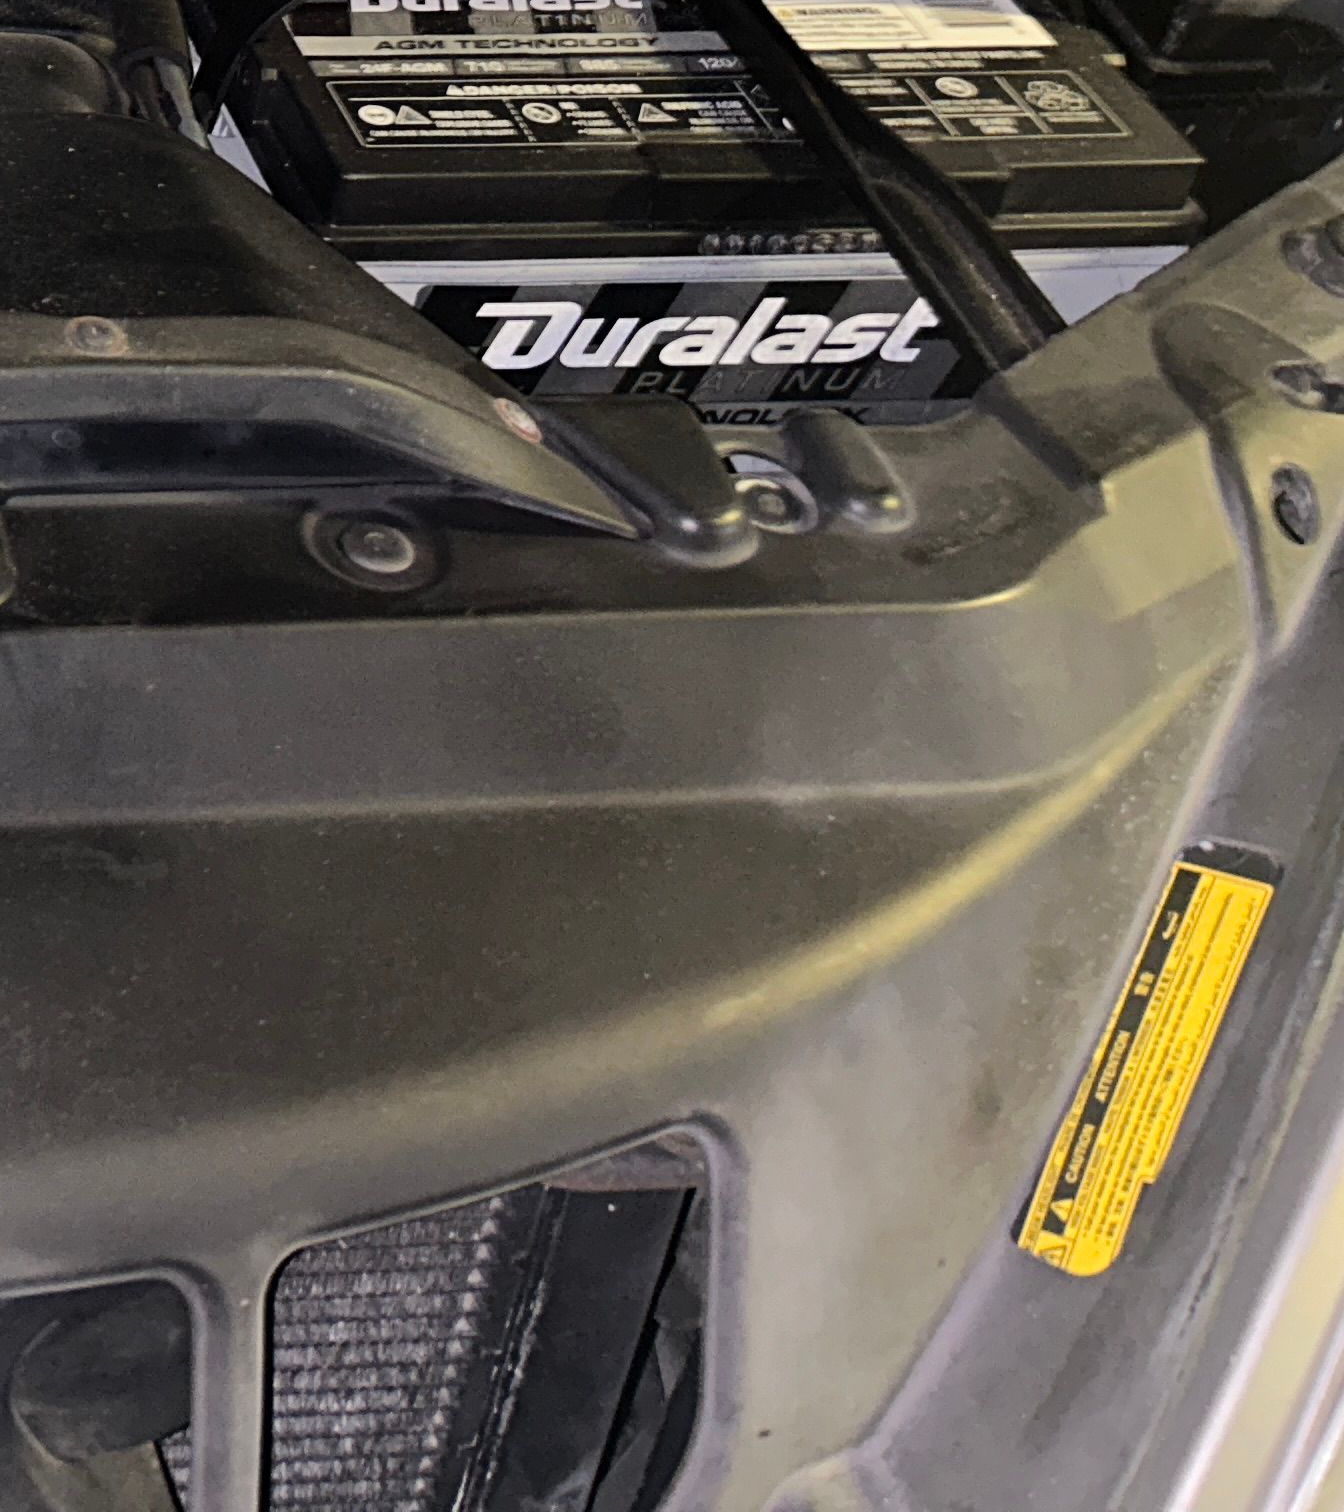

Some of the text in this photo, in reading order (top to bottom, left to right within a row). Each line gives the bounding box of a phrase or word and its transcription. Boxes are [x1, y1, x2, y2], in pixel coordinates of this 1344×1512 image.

[468, 13, 648, 28] PLATINUM
[374, 37, 659, 51] AGM TECHNOLOGY
[475, 297, 940, 369] Duralast
[629, 368, 909, 394] PLATINUM
[1064, 1030, 1132, 1184] CAUTION ATTENTION
